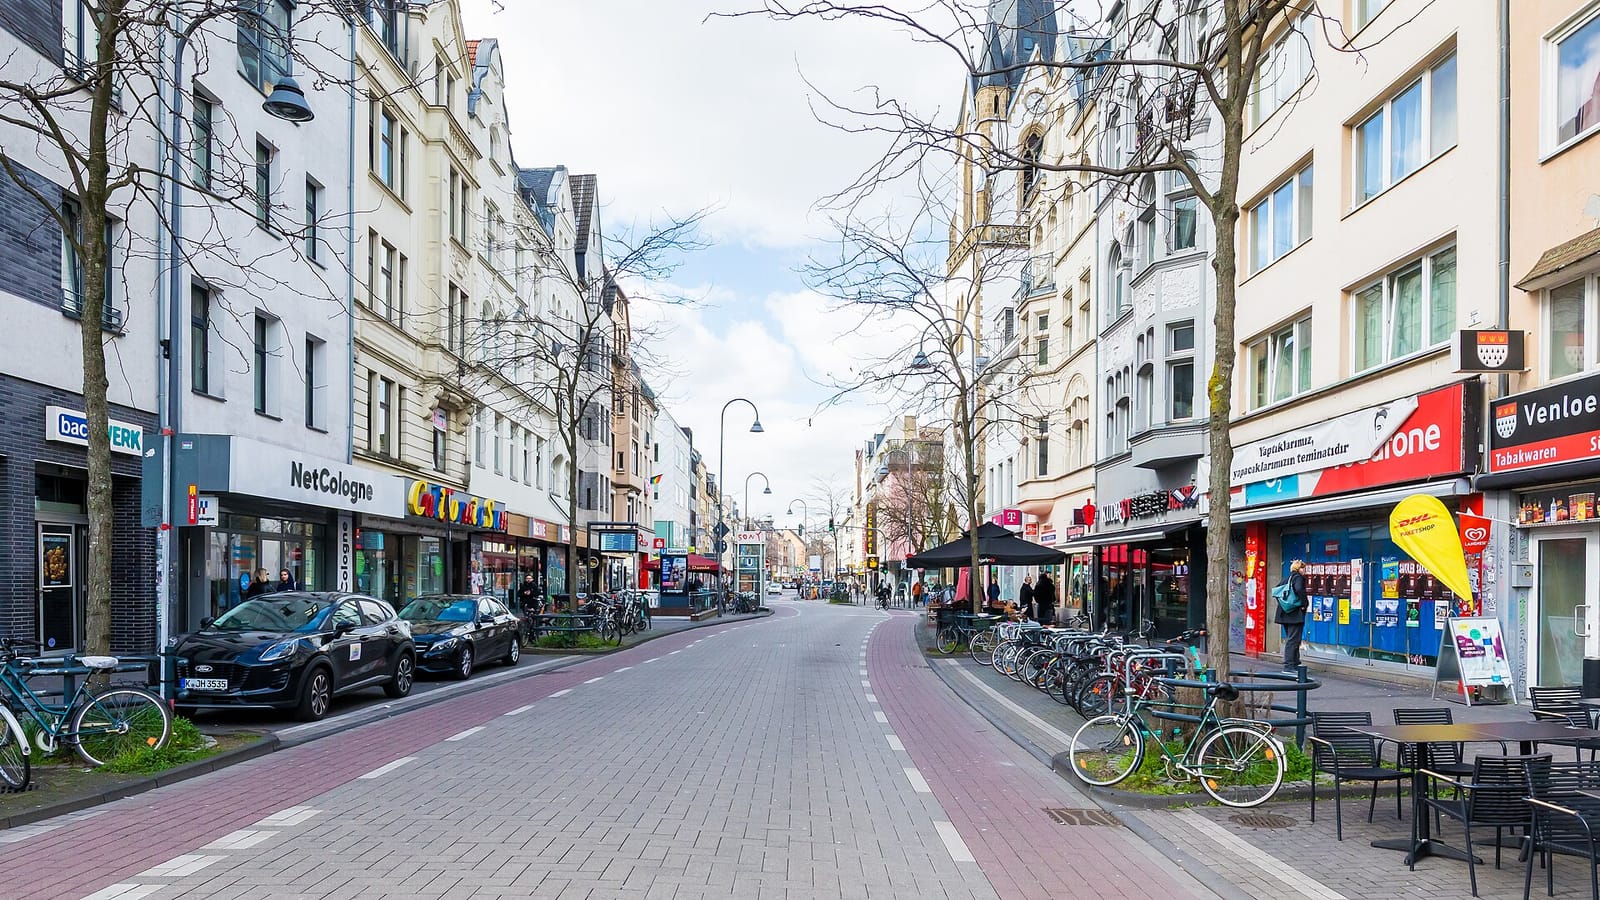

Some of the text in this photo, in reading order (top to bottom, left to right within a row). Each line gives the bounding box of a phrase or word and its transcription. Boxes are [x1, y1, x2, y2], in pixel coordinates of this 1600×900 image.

[1524, 395, 1597, 426] Venloe
[1495, 446, 1557, 466] Tabakwaren
[291, 461, 373, 504] NetCologne
[1400, 513, 1431, 527] DHL
[1401, 524, 1435, 537] PAKETSHOP
[340, 521, 350, 592] Cologne
[206, 680, 226, 688] 3535
